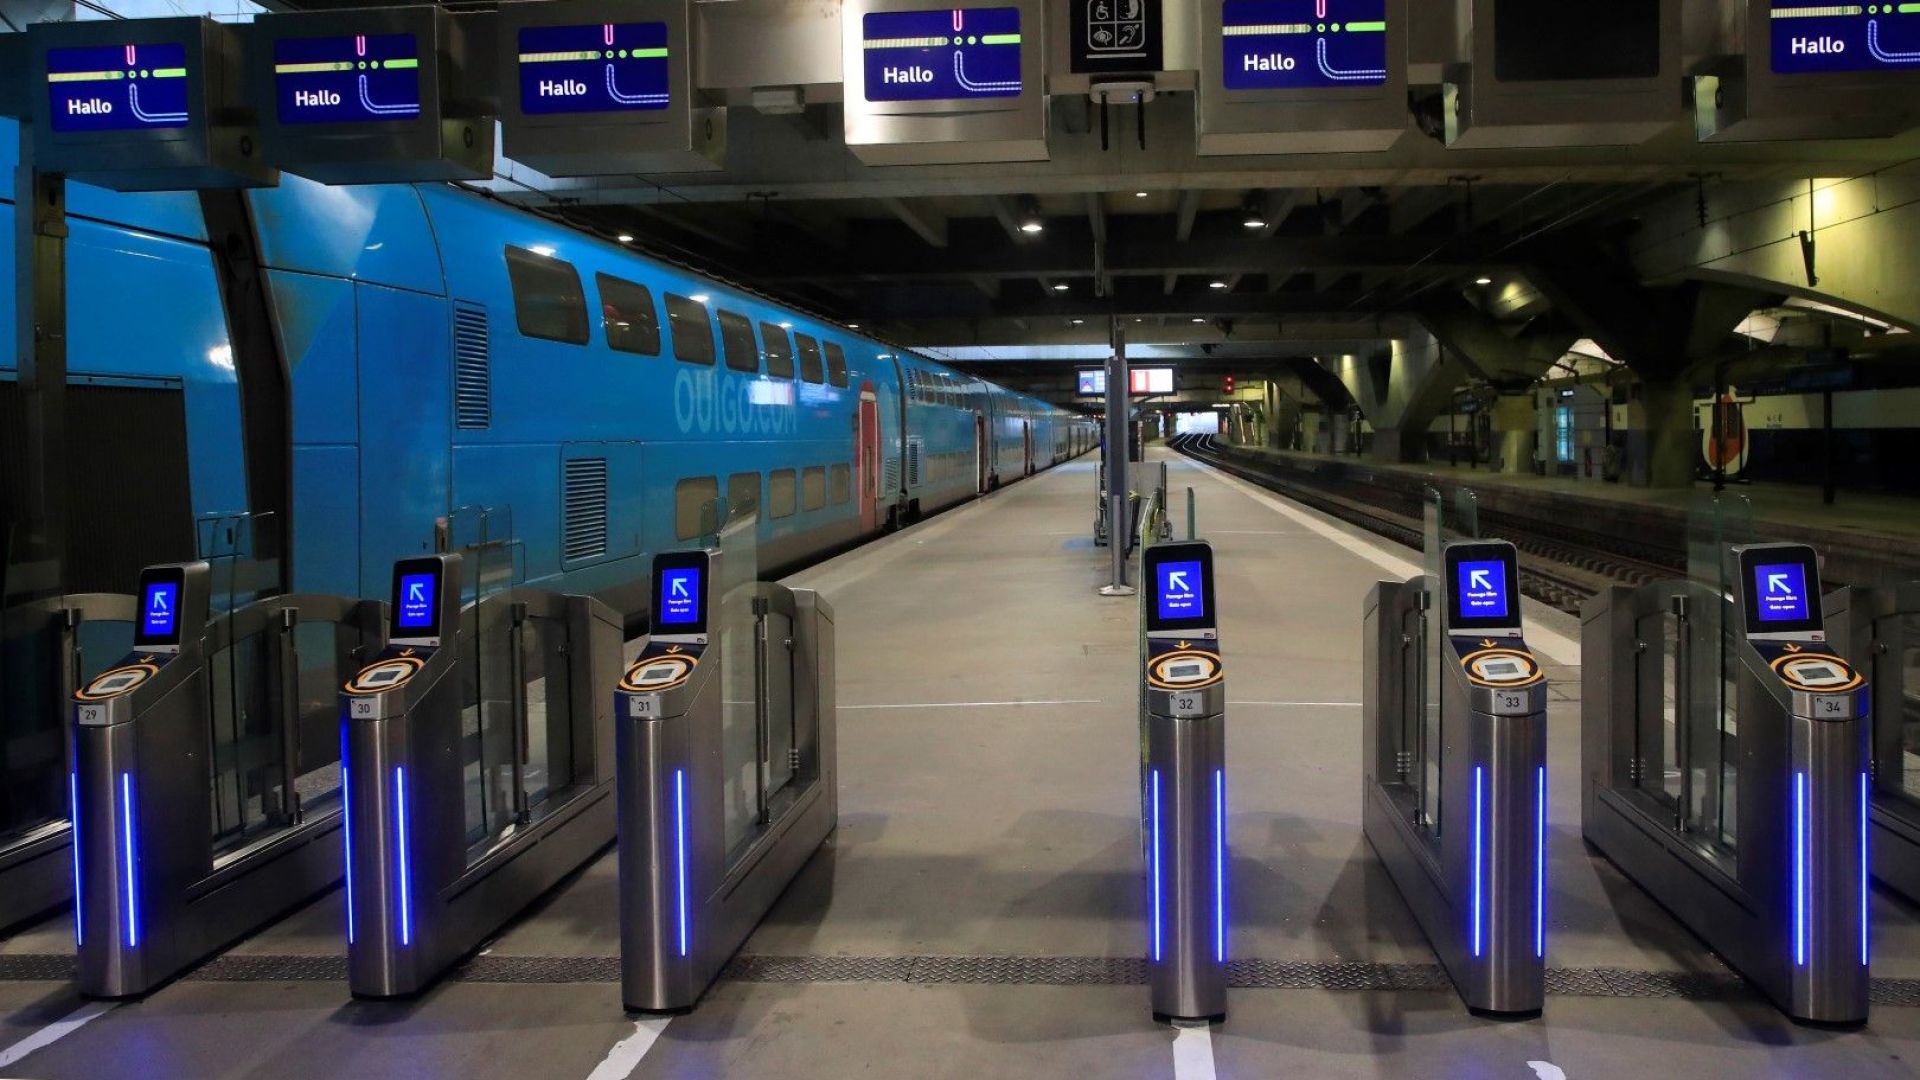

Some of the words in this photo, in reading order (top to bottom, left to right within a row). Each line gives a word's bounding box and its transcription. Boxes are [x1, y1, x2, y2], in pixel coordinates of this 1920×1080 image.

[1791, 36, 1845, 55] Hallo
[1243, 53, 1295, 72] Hallo
[883, 65, 934, 84] Hallo
[539, 79, 587, 97] Hallo
[295, 89, 341, 107] Hallo
[68, 98, 113, 115] Hallo
[357, 703, 371, 714] 30
[638, 701, 650, 712] 31
[1178, 699, 1193, 710] 32
[1505, 696, 1520, 708] 33
[1825, 701, 1841, 712] 34
[85, 709, 97, 720] 29
